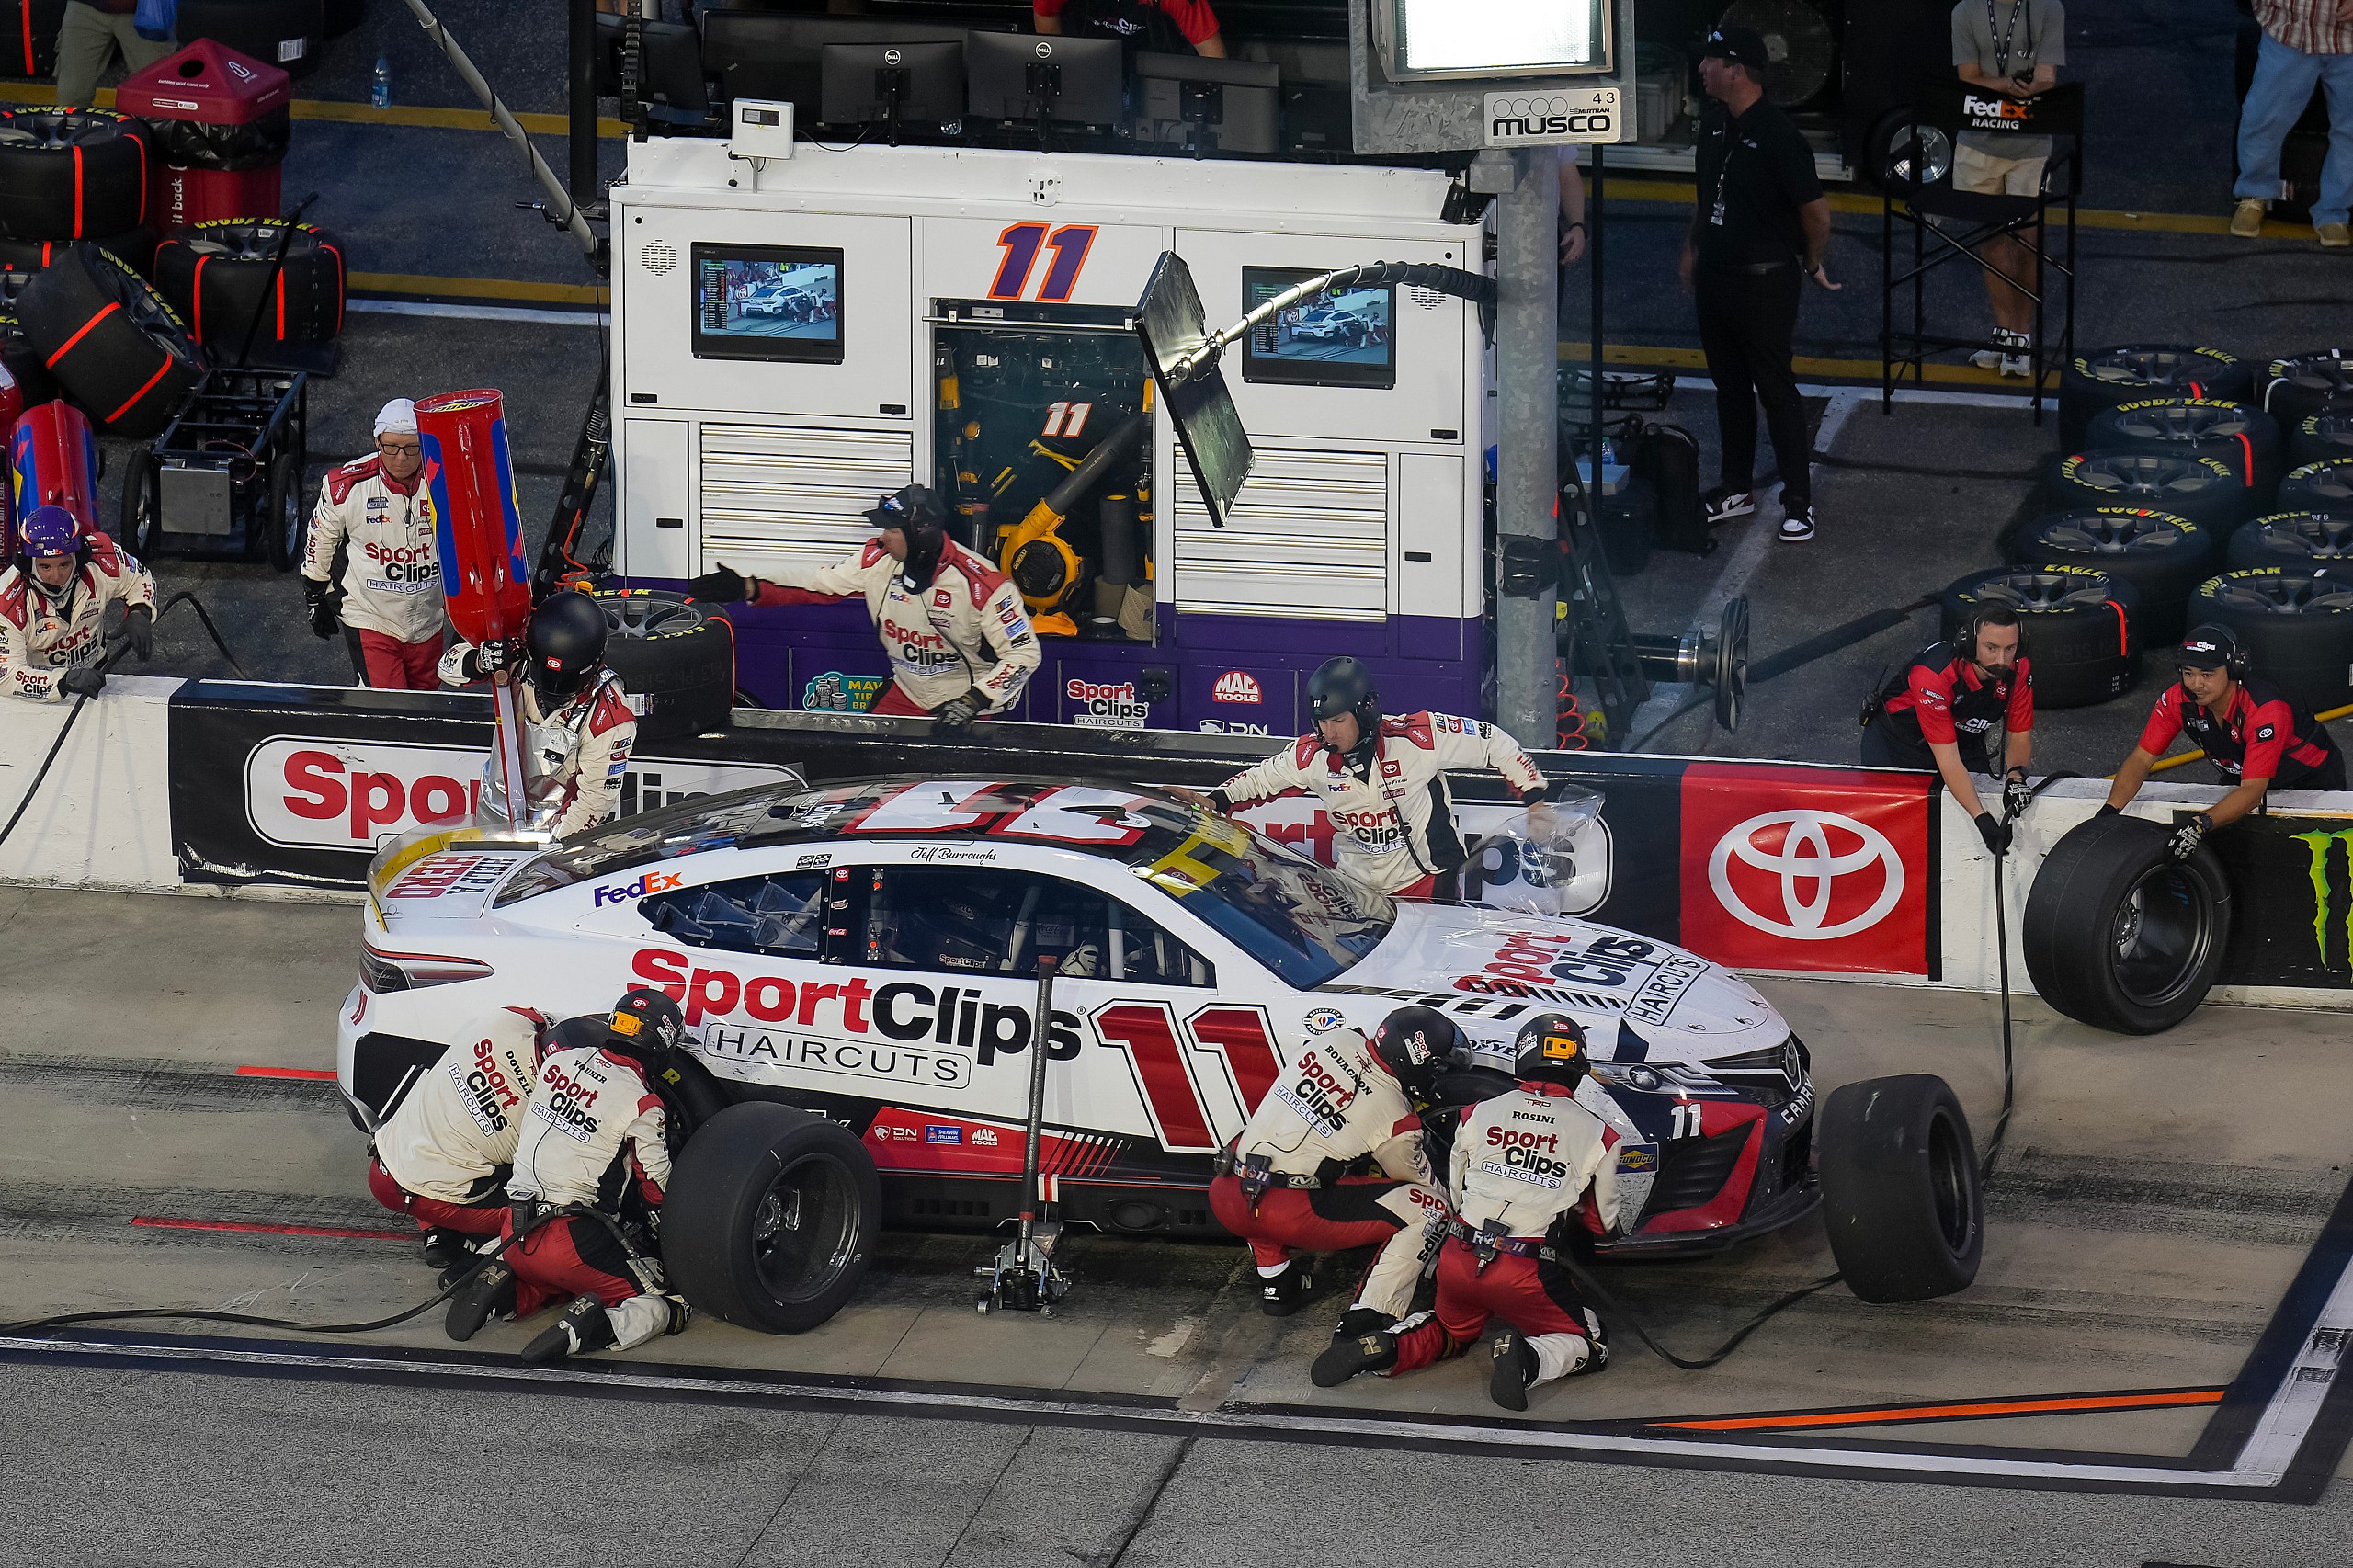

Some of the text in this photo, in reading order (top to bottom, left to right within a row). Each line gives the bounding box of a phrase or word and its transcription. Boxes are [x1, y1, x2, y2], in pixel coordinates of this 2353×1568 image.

[1963, 94, 2029, 119] FedEx
[1972, 118, 2020, 130] RACING
[171, 177, 184, 211] back
[988, 222, 1100, 302] 11
[1041, 401, 1093, 438] 11
[365, 542, 430, 565] Sport
[385, 561, 439, 583] Clips
[884, 619, 944, 649] Sport
[904, 643, 961, 665] Clips
[15, 670, 49, 685] Sport
[1068, 680, 1134, 701] Sport
[1215, 672, 1258, 694] MAC
[1090, 699, 1147, 719] Clips
[1215, 692, 1259, 702] TOOLS
[1077, 717, 1141, 727] HAIRCUTS
[1328, 784, 1351, 792] FedEx
[910, 847, 997, 865] Jeff Burroughs
[594, 871, 684, 908] FedEx
[1631, 957, 1701, 1022] HAIRCUTS
[716, 1028, 960, 1083] HAIRCUTS
[1324, 1044, 1373, 1096] BOUAGNON
[473, 1038, 521, 1111] Sport
[505, 1050, 533, 1098] DOWELL
[543, 1064, 599, 1108] Sport
[1088, 998, 1287, 1152] 11
[1298, 1051, 1355, 1108] Sport
[450, 1066, 492, 1134] HAIRCUTS
[466, 1070, 509, 1132] Clips
[549, 1092, 599, 1133] Clips
[1276, 1085, 1331, 1136] HAIRCUTS
[1295, 1078, 1347, 1131] Clips
[1524, 1097, 1552, 1108] TRD
[533, 1103, 588, 1142] HAIRCUTS
[1512, 1110, 1556, 1125] ROSINI
[1671, 1103, 1701, 1140] 11
[971, 1128, 998, 1141] MAC
[1486, 1126, 1559, 1154] Sport
[1483, 1163, 1558, 1188] HAIRCUTS
[1505, 1146, 1567, 1179] Clips
